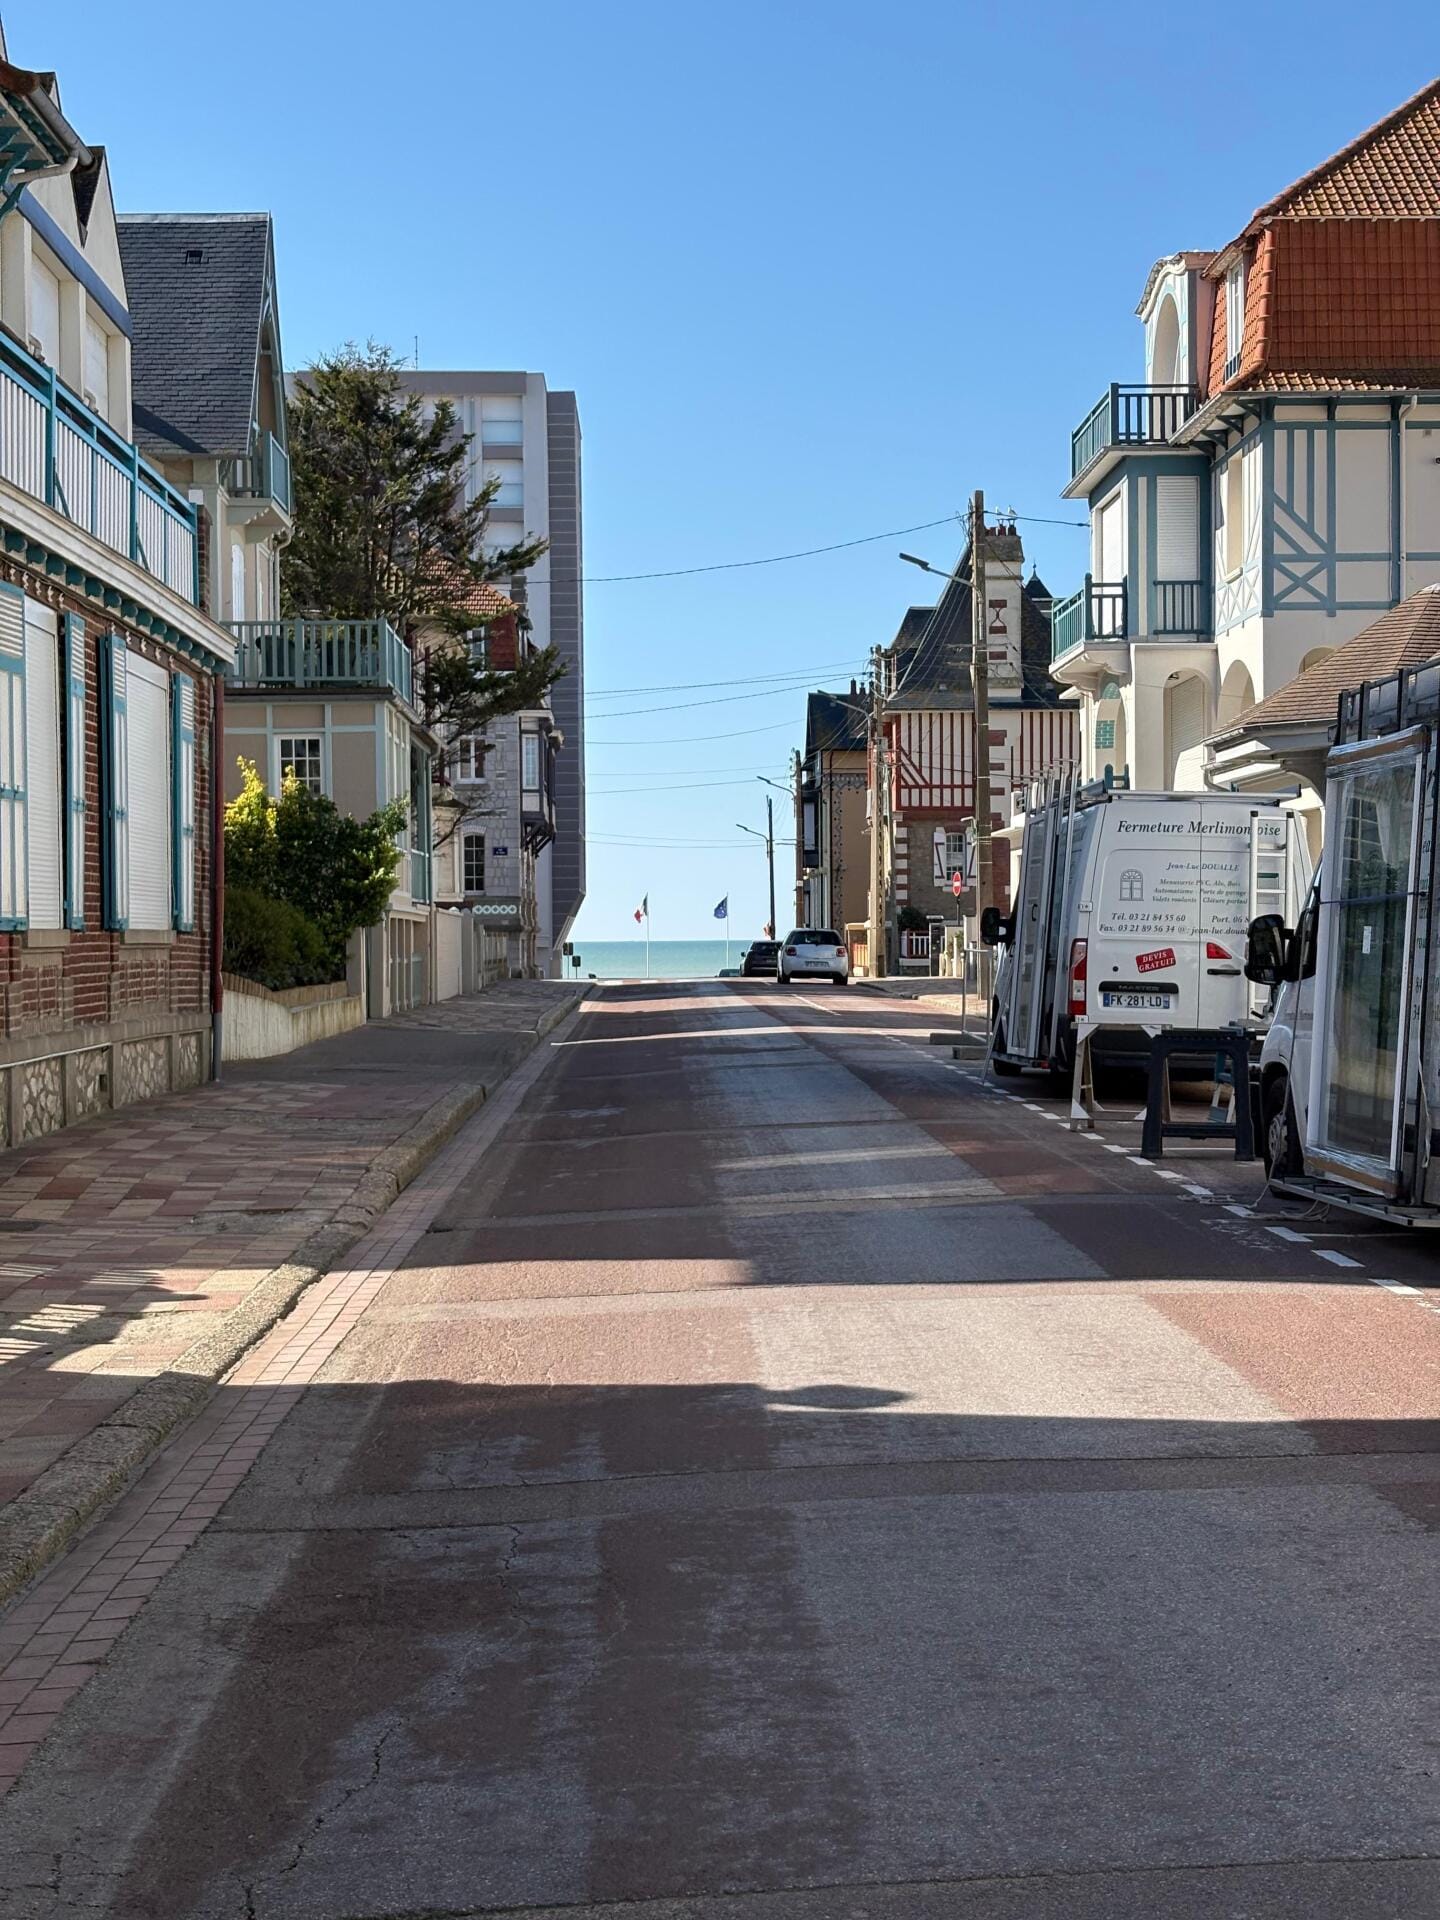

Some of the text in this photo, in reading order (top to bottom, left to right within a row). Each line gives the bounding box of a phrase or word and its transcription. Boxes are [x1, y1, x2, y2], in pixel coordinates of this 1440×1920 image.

[1117, 820, 1281, 836] Fermeture Merlimonoise
[1166, 862, 1200, 871] Jean-Luc
[1128, 913, 1139, 921] 03
[1140, 913, 1150, 921] 21
[1175, 914, 1186, 922] 60
[1099, 923, 1175, 933] Fax. 03 21 89 56 34
[1142, 951, 1167, 963] DEVIS
[1139, 958, 1174, 972] GRATUIT
[1110, 994, 1162, 1007] FK-281-LD
